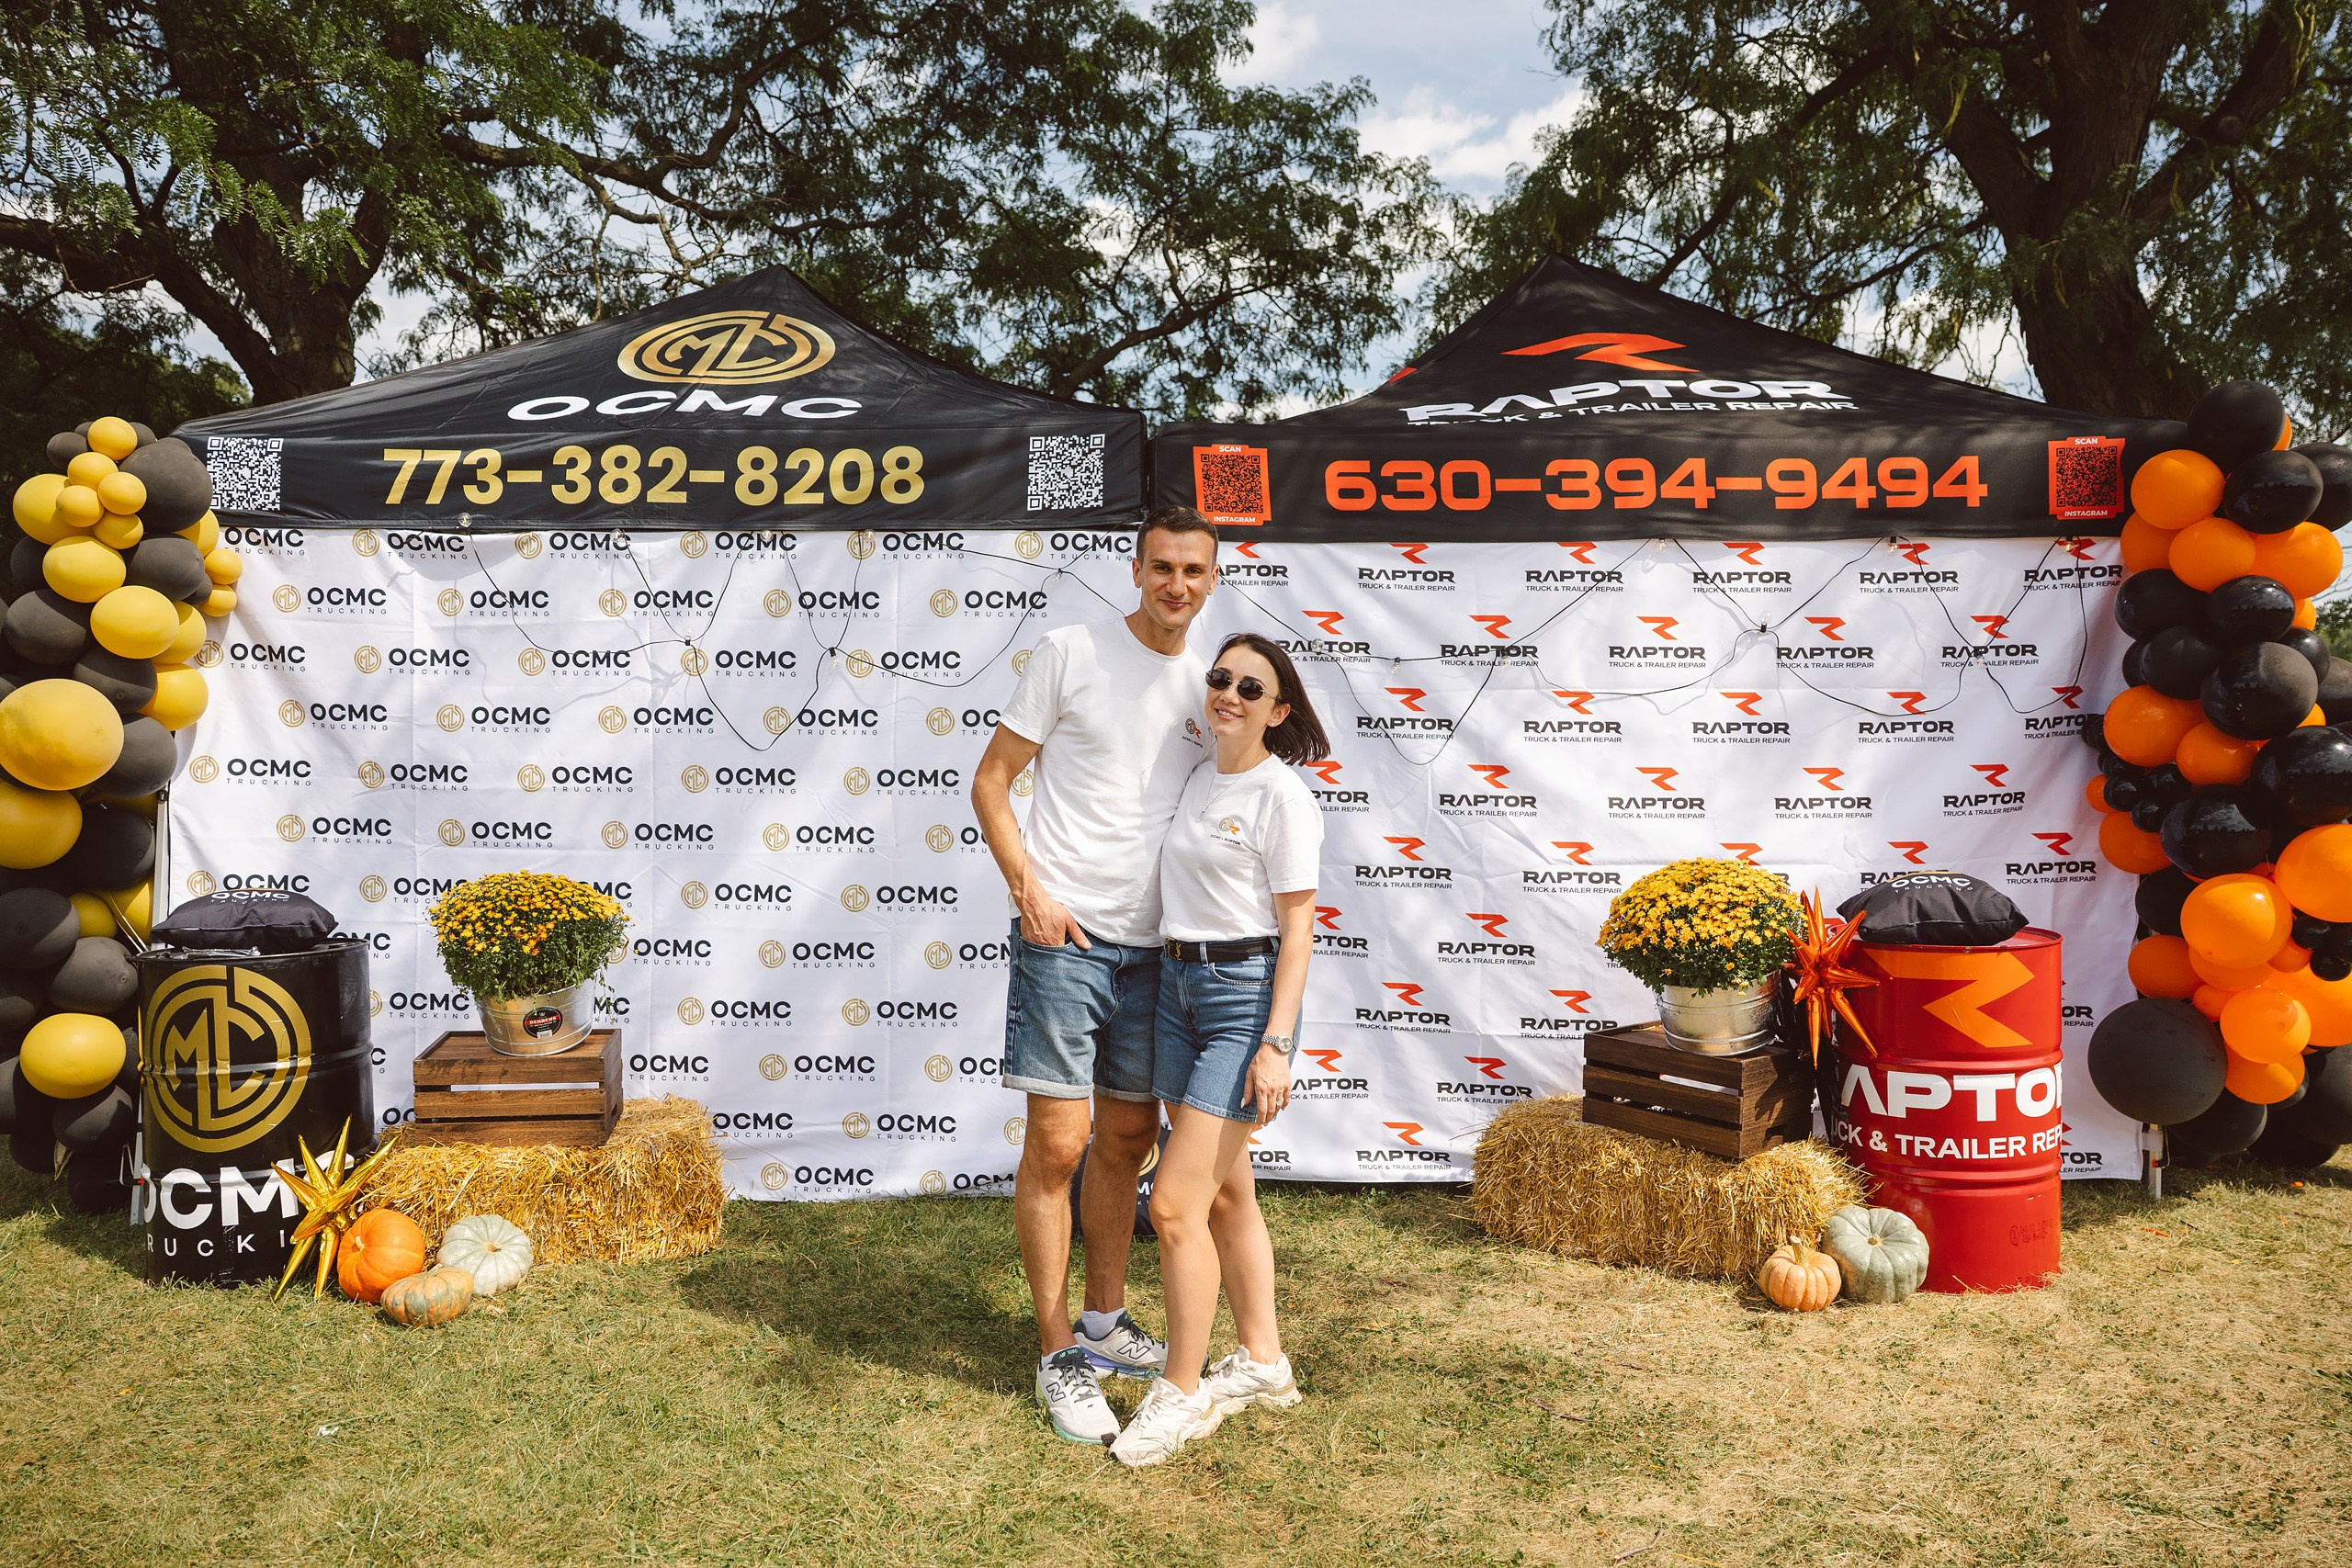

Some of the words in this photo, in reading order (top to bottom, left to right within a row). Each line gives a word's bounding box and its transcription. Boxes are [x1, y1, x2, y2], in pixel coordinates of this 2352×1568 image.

[507, 389, 862, 422] OCMC
[1398, 379, 1852, 421] RAPTOR
[1573, 401, 1721, 415] TRAILER
[1727, 401, 1860, 410] REPAIR
[383, 445, 925, 506] 773-382-8208
[1325, 455, 1988, 512] 630-394-9494
[882, 532, 965, 551] OCMC
[882, 552, 966, 560] TRUCKING
[1357, 567, 1456, 584] RAPTOR
[308, 587, 386, 605] OCMC
[1393, 583, 1426, 592] TRAILER
[307, 606, 387, 615] TRUCKING
[231, 644, 305, 663] OCMC
[389, 649, 469, 667] OCMC
[716, 650, 796, 669] OCMC
[1608, 646, 1706, 660] RAPTOR
[230, 662, 306, 672] TRUCKING
[388, 668, 470, 676] TRUCKING
[715, 670, 797, 678] TRUCKING
[311, 704, 387, 722] OCMC
[472, 707, 550, 725] OCMC
[311, 721, 389, 731] TRUCKING
[470, 726, 551, 734] TRUCKING
[1522, 720, 1623, 735] RAPTOR
[1691, 721, 1791, 736] RAPTOR
[1858, 720, 1955, 736] RAPTOR
[228, 759, 311, 777] OCMC
[390, 764, 468, 783] OCMC
[552, 766, 632, 784] OCMC
[716, 768, 796, 785] OCMC
[226, 777, 311, 787] TRUCKING
[877, 770, 958, 787] OCMC
[390, 783, 469, 792] TRUCKING
[1439, 794, 1537, 809] RAPTOR
[1774, 796, 1872, 811] RAPTOR
[1942, 791, 2026, 809] RAPTOR
[1942, 809, 1967, 818] TRUCK
[1974, 807, 2002, 816] TRAILER
[2002, 805, 2024, 814] REPAIR
[312, 818, 391, 836] OCMC
[472, 822, 551, 840] OCMC
[635, 824, 713, 841] OCMC
[797, 826, 874, 844] OCMC
[311, 836, 392, 845] TRUCKING
[471, 840, 553, 849] TRUCKING
[634, 842, 714, 851] TRUCKING
[795, 845, 876, 853] TRUCKING
[1354, 864, 1453, 882] RAPTOR
[2005, 861, 2098, 876] RAPTOR
[1423, 882, 1453, 890] REPAIR
[1521, 870, 1622, 886] RAPTOR
[1892, 875, 1971, 888] OCMC
[2039, 875, 2069, 884] TRAILER
[211, 891, 290, 899] OCMC
[715, 884, 791, 903] OCMC
[876, 886, 957, 904] OCMC
[714, 903, 792, 912] TRUCKING
[634, 939, 711, 957] OCMC
[793, 942, 874, 960] OCMC
[1437, 942, 1536, 959] RAPTOR
[633, 958, 711, 967] TRUCKING
[1507, 958, 1536, 966] REPAIR
[711, 1000, 791, 1019] OCMC
[877, 1001, 957, 1019] OCMC
[1354, 1008, 1452, 1027] RAPTOR
[710, 1020, 792, 1028] TRUCKING
[876, 1020, 958, 1028] TRUCKING
[1390, 1024, 1422, 1032] TRAILER
[1422, 1026, 1452, 1034] REPAIR
[630, 1055, 708, 1073] OCMC
[795, 1055, 875, 1073] OCMC
[628, 1074, 709, 1082] TRUCKING
[794, 1074, 876, 1082] TRUCKING
[1841, 1060, 2062, 1122] APTO
[877, 1114, 956, 1134] OCMC
[876, 1133, 956, 1143] TRUCKING
[1831, 1114, 1863, 1147] UCK
[1869, 1131, 1888, 1153] &
[1894, 1134, 2027, 1159] TRAILER
[2032, 1123, 2062, 1155] REP
[795, 1167, 874, 1186] OCMC
[148, 1230, 285, 1257] RUCKI
